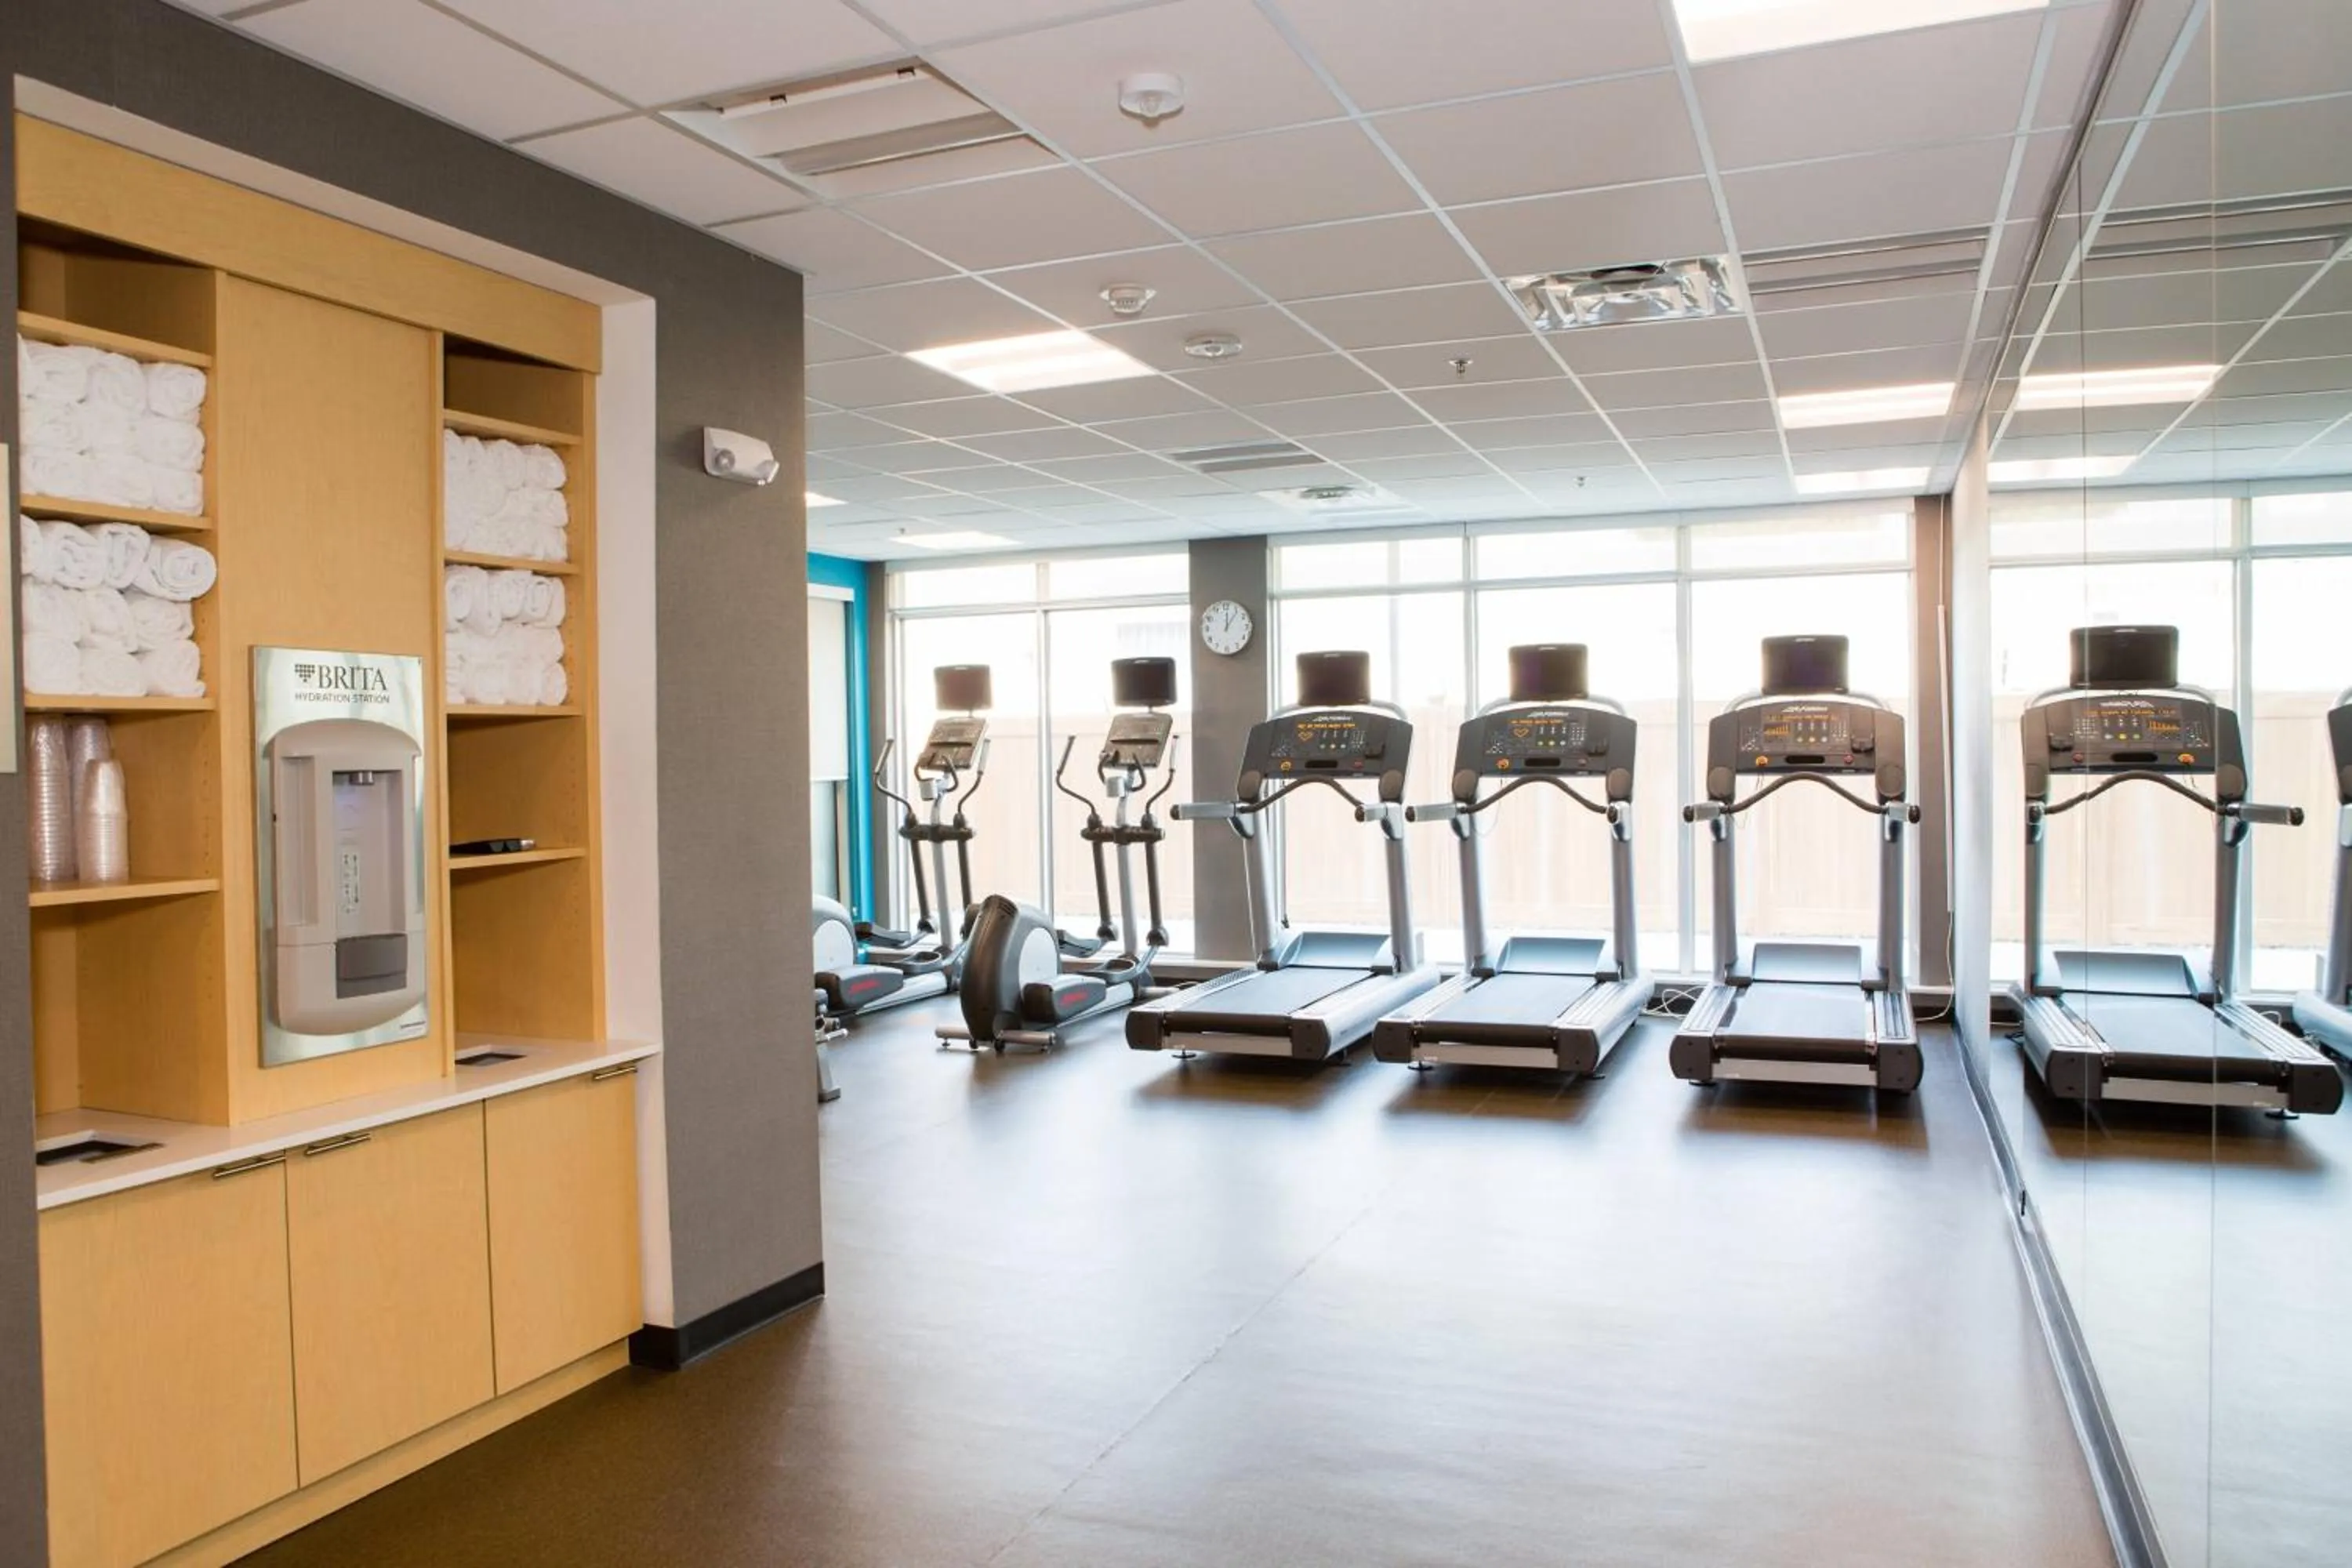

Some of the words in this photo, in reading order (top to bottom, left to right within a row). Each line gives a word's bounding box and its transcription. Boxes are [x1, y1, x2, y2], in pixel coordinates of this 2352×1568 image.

[318, 665, 387, 690] BRITA
[295, 692, 350, 703] HYDRATION
[352, 694, 390, 703] STATION
